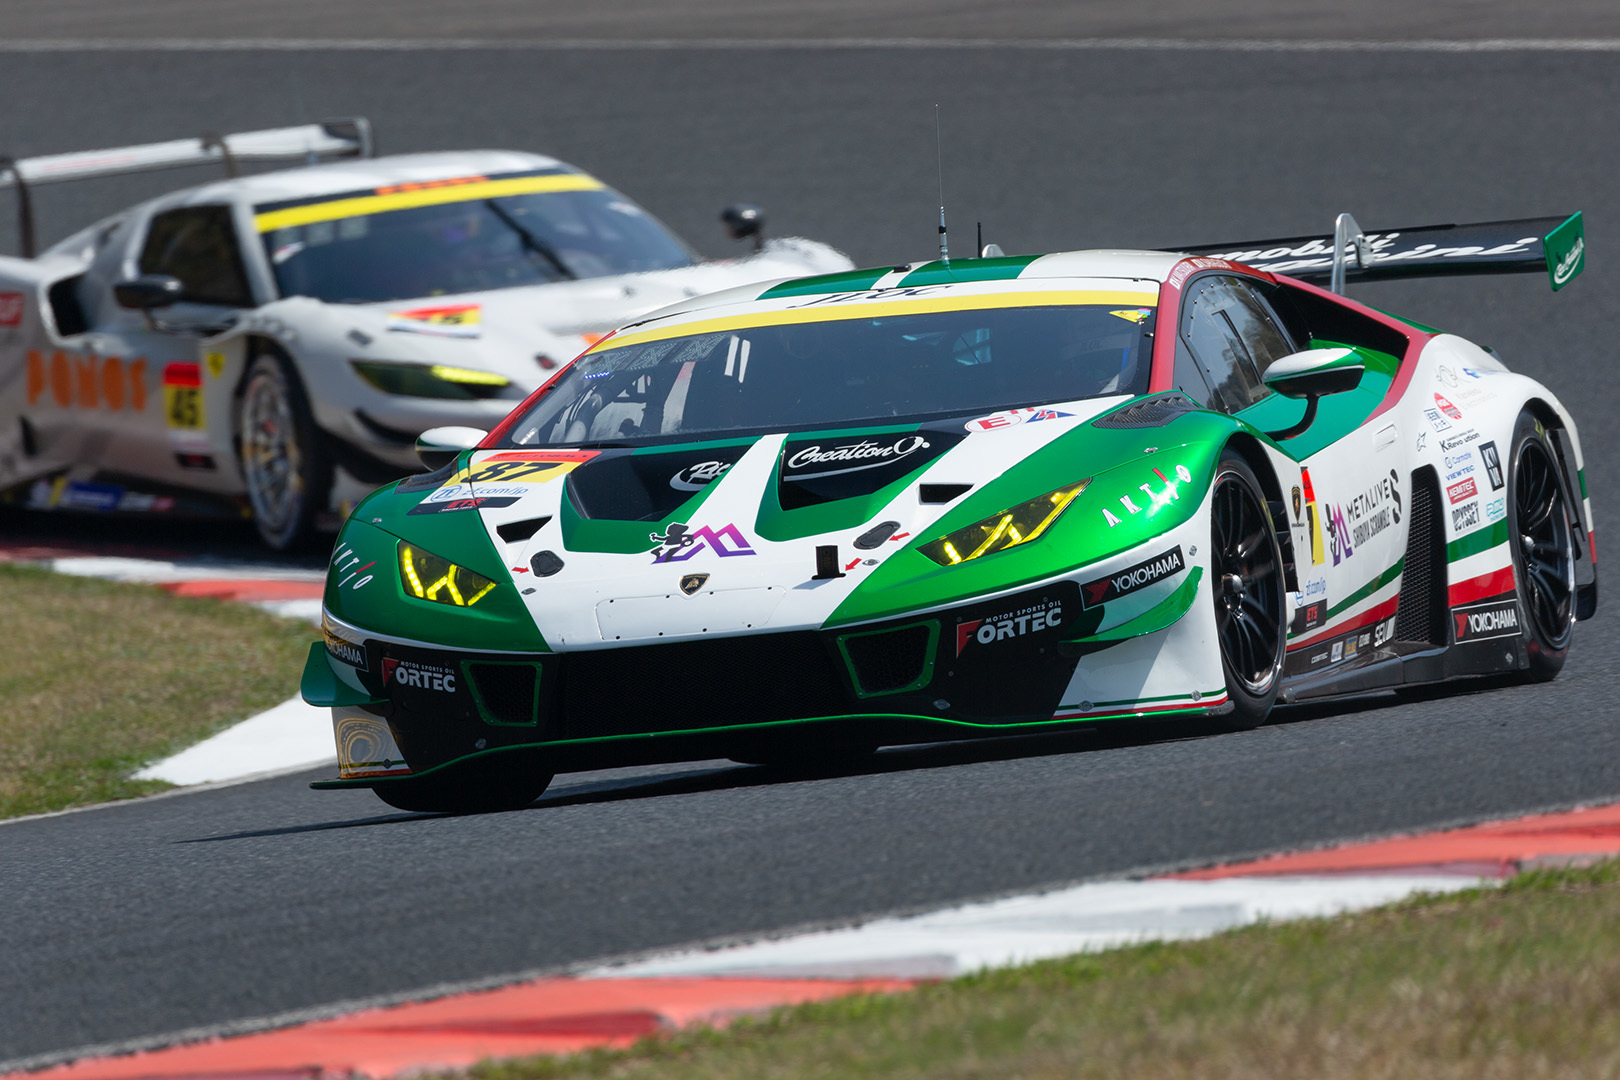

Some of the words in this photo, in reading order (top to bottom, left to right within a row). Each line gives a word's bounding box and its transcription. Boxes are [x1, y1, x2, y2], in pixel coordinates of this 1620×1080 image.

[171, 389, 198, 427] 45
[460, 462, 564, 483] 87
[1446, 465, 1475, 481] VIEWTEC
[461, 486, 529, 498] zf.com/jp
[1346, 478, 1390, 524] METALIVE
[1111, 553, 1181, 593] YOKOHAMA
[985, 612, 1014, 624] MOTOR
[1017, 603, 1046, 617] SPORTS
[1048, 600, 1062, 609] OIL
[1468, 608, 1518, 634] YOKOHAMA
[400, 660, 420, 669] MOTOR
[421, 664, 443, 673] SPORTS
